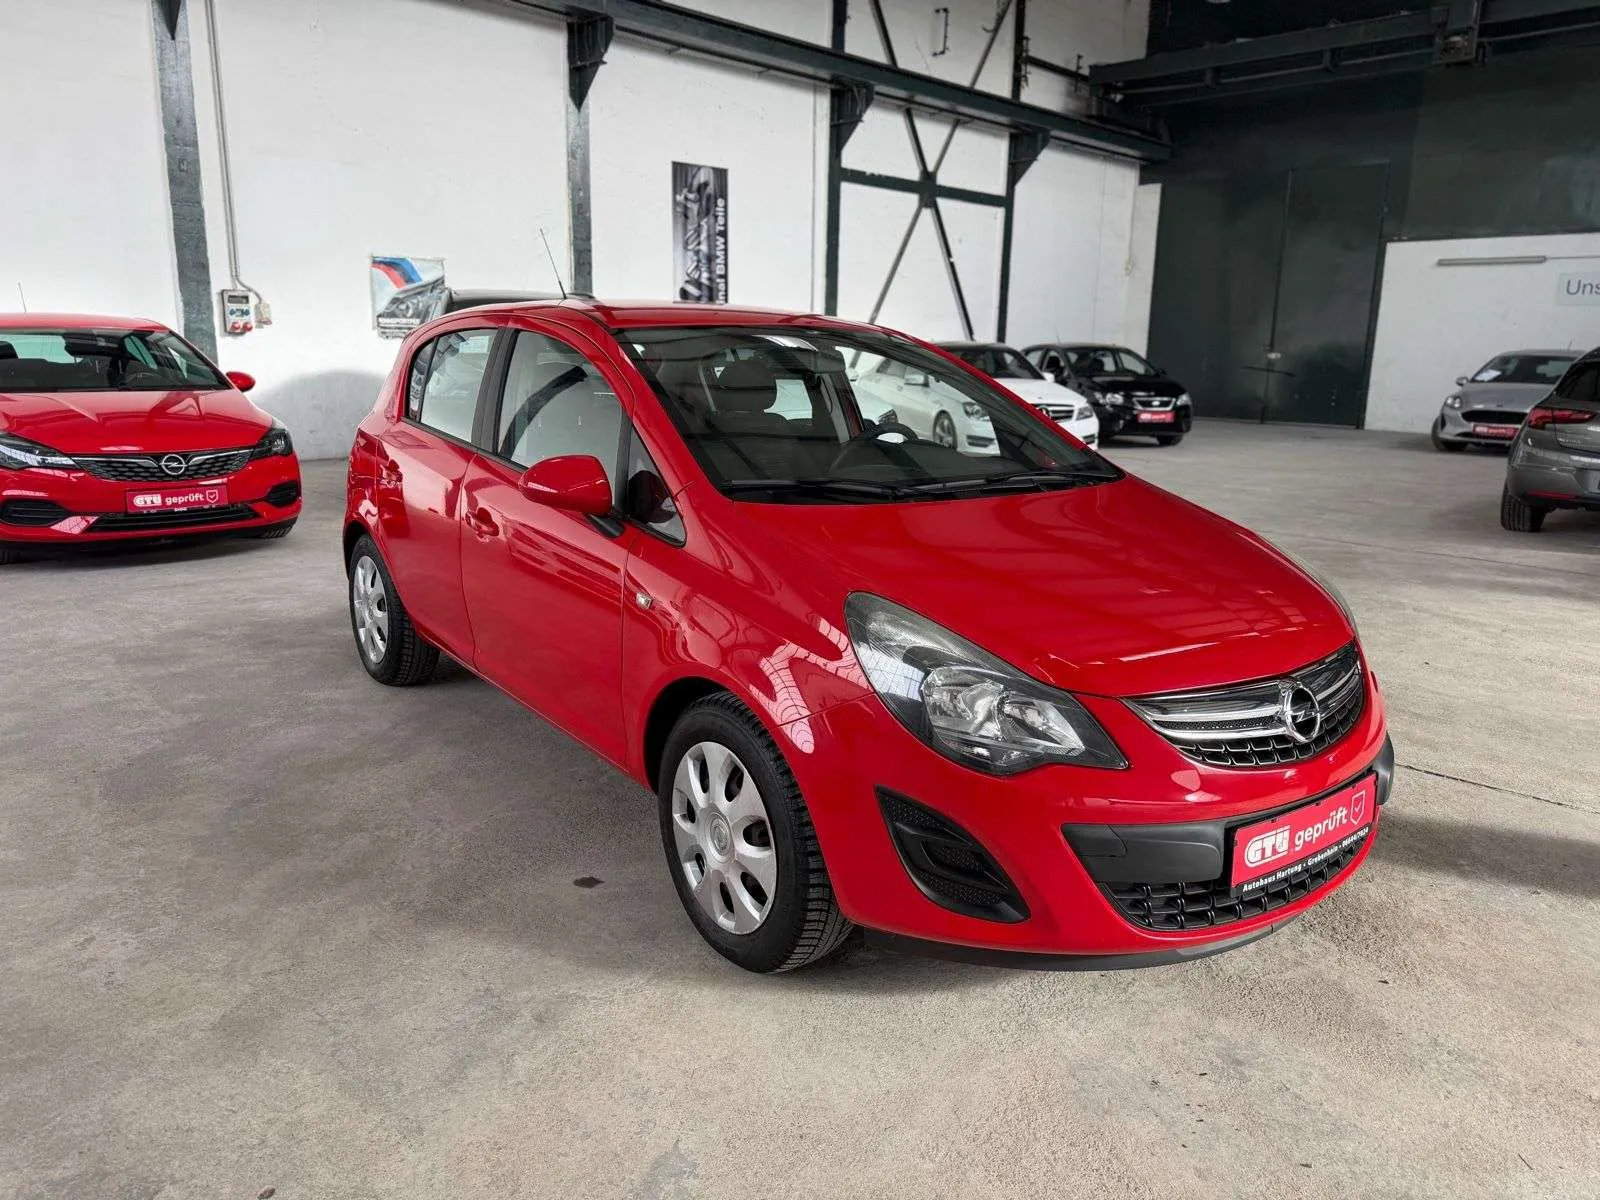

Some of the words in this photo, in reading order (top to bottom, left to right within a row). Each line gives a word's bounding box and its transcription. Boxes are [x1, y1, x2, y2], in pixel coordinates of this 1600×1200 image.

[715, 198, 726, 233] Teile
[715, 236, 726, 275] BMW
[165, 493, 204, 505] geprüft
[1295, 806, 1348, 851] geprüft
[1242, 875, 1276, 892] Autohaus
[1276, 863, 1302, 880] Hartung
